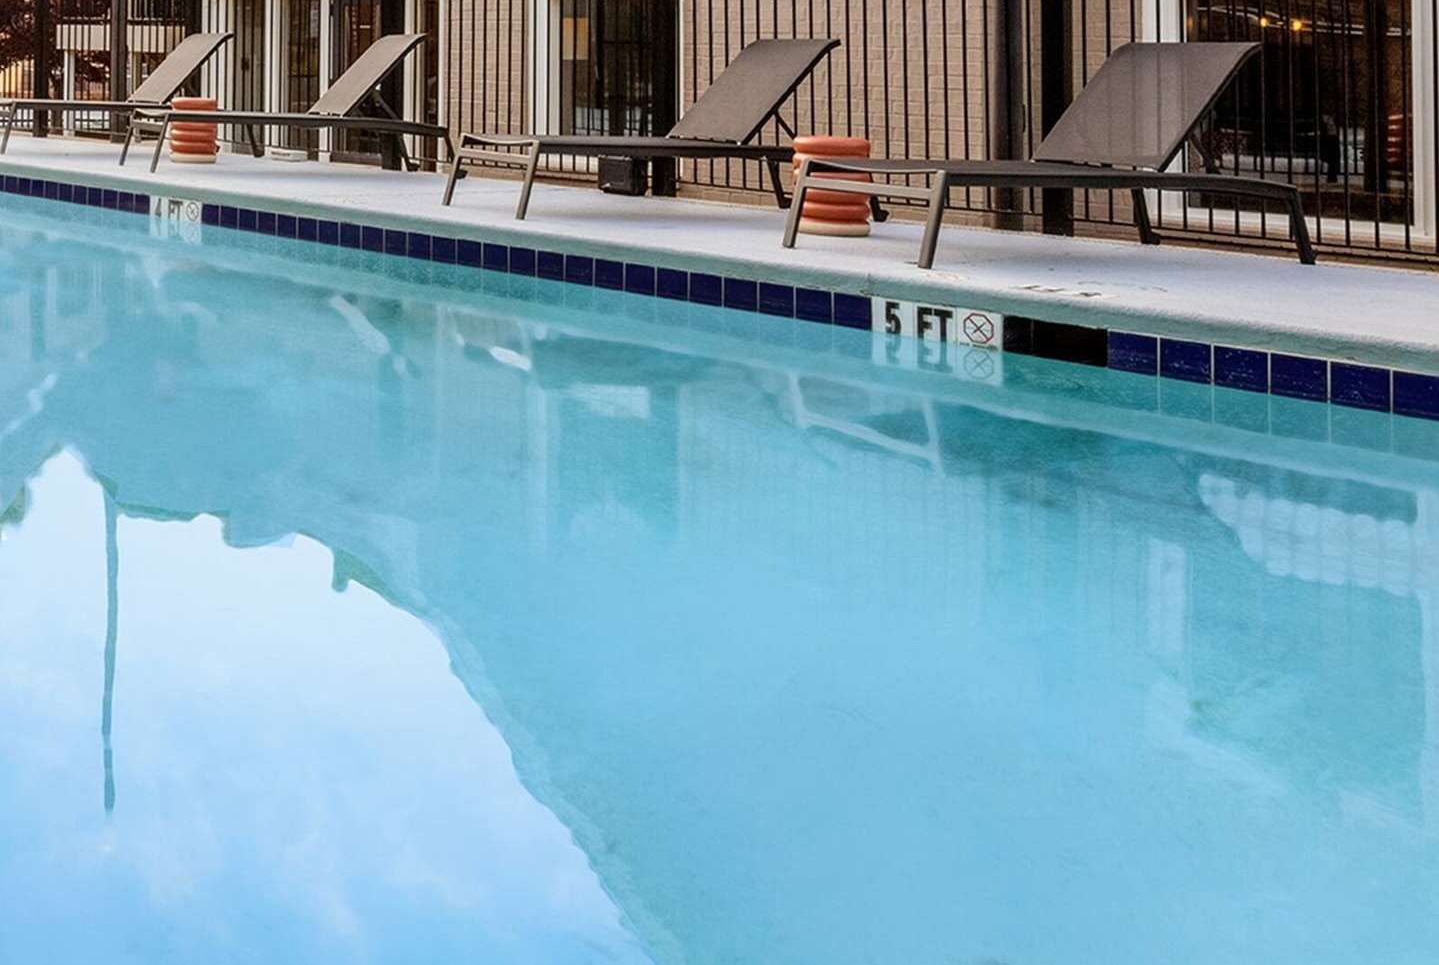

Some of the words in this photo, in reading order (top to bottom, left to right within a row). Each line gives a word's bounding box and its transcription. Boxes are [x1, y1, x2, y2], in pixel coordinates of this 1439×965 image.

[155, 198, 162, 220] 4
[168, 199, 183, 221] FT
[884, 301, 901, 334] 5
[917, 306, 953, 342] FT
